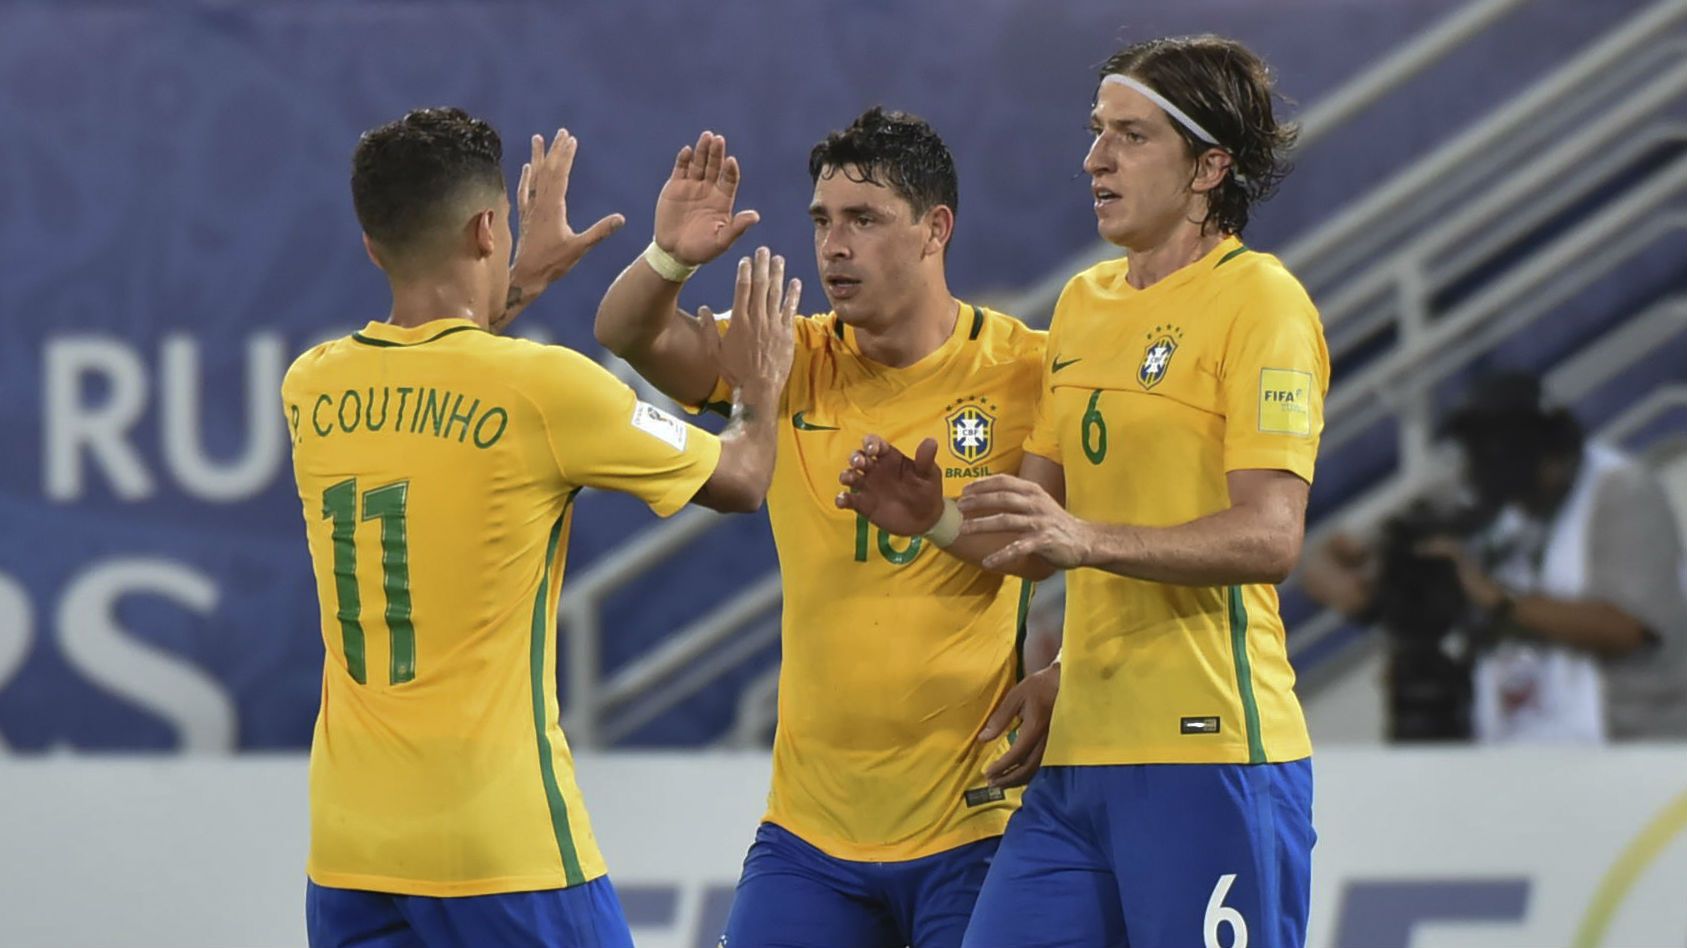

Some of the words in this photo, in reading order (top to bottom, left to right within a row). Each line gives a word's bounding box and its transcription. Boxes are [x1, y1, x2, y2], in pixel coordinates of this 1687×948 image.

[44, 336, 284, 502] RU
[312, 387, 508, 449] COUTINHO
[1081, 388, 1107, 465] 6
[1264, 390, 1294, 402] FIFA
[945, 465, 992, 479] BRASIL
[322, 477, 416, 685] 11
[1203, 873, 1248, 948] 6
